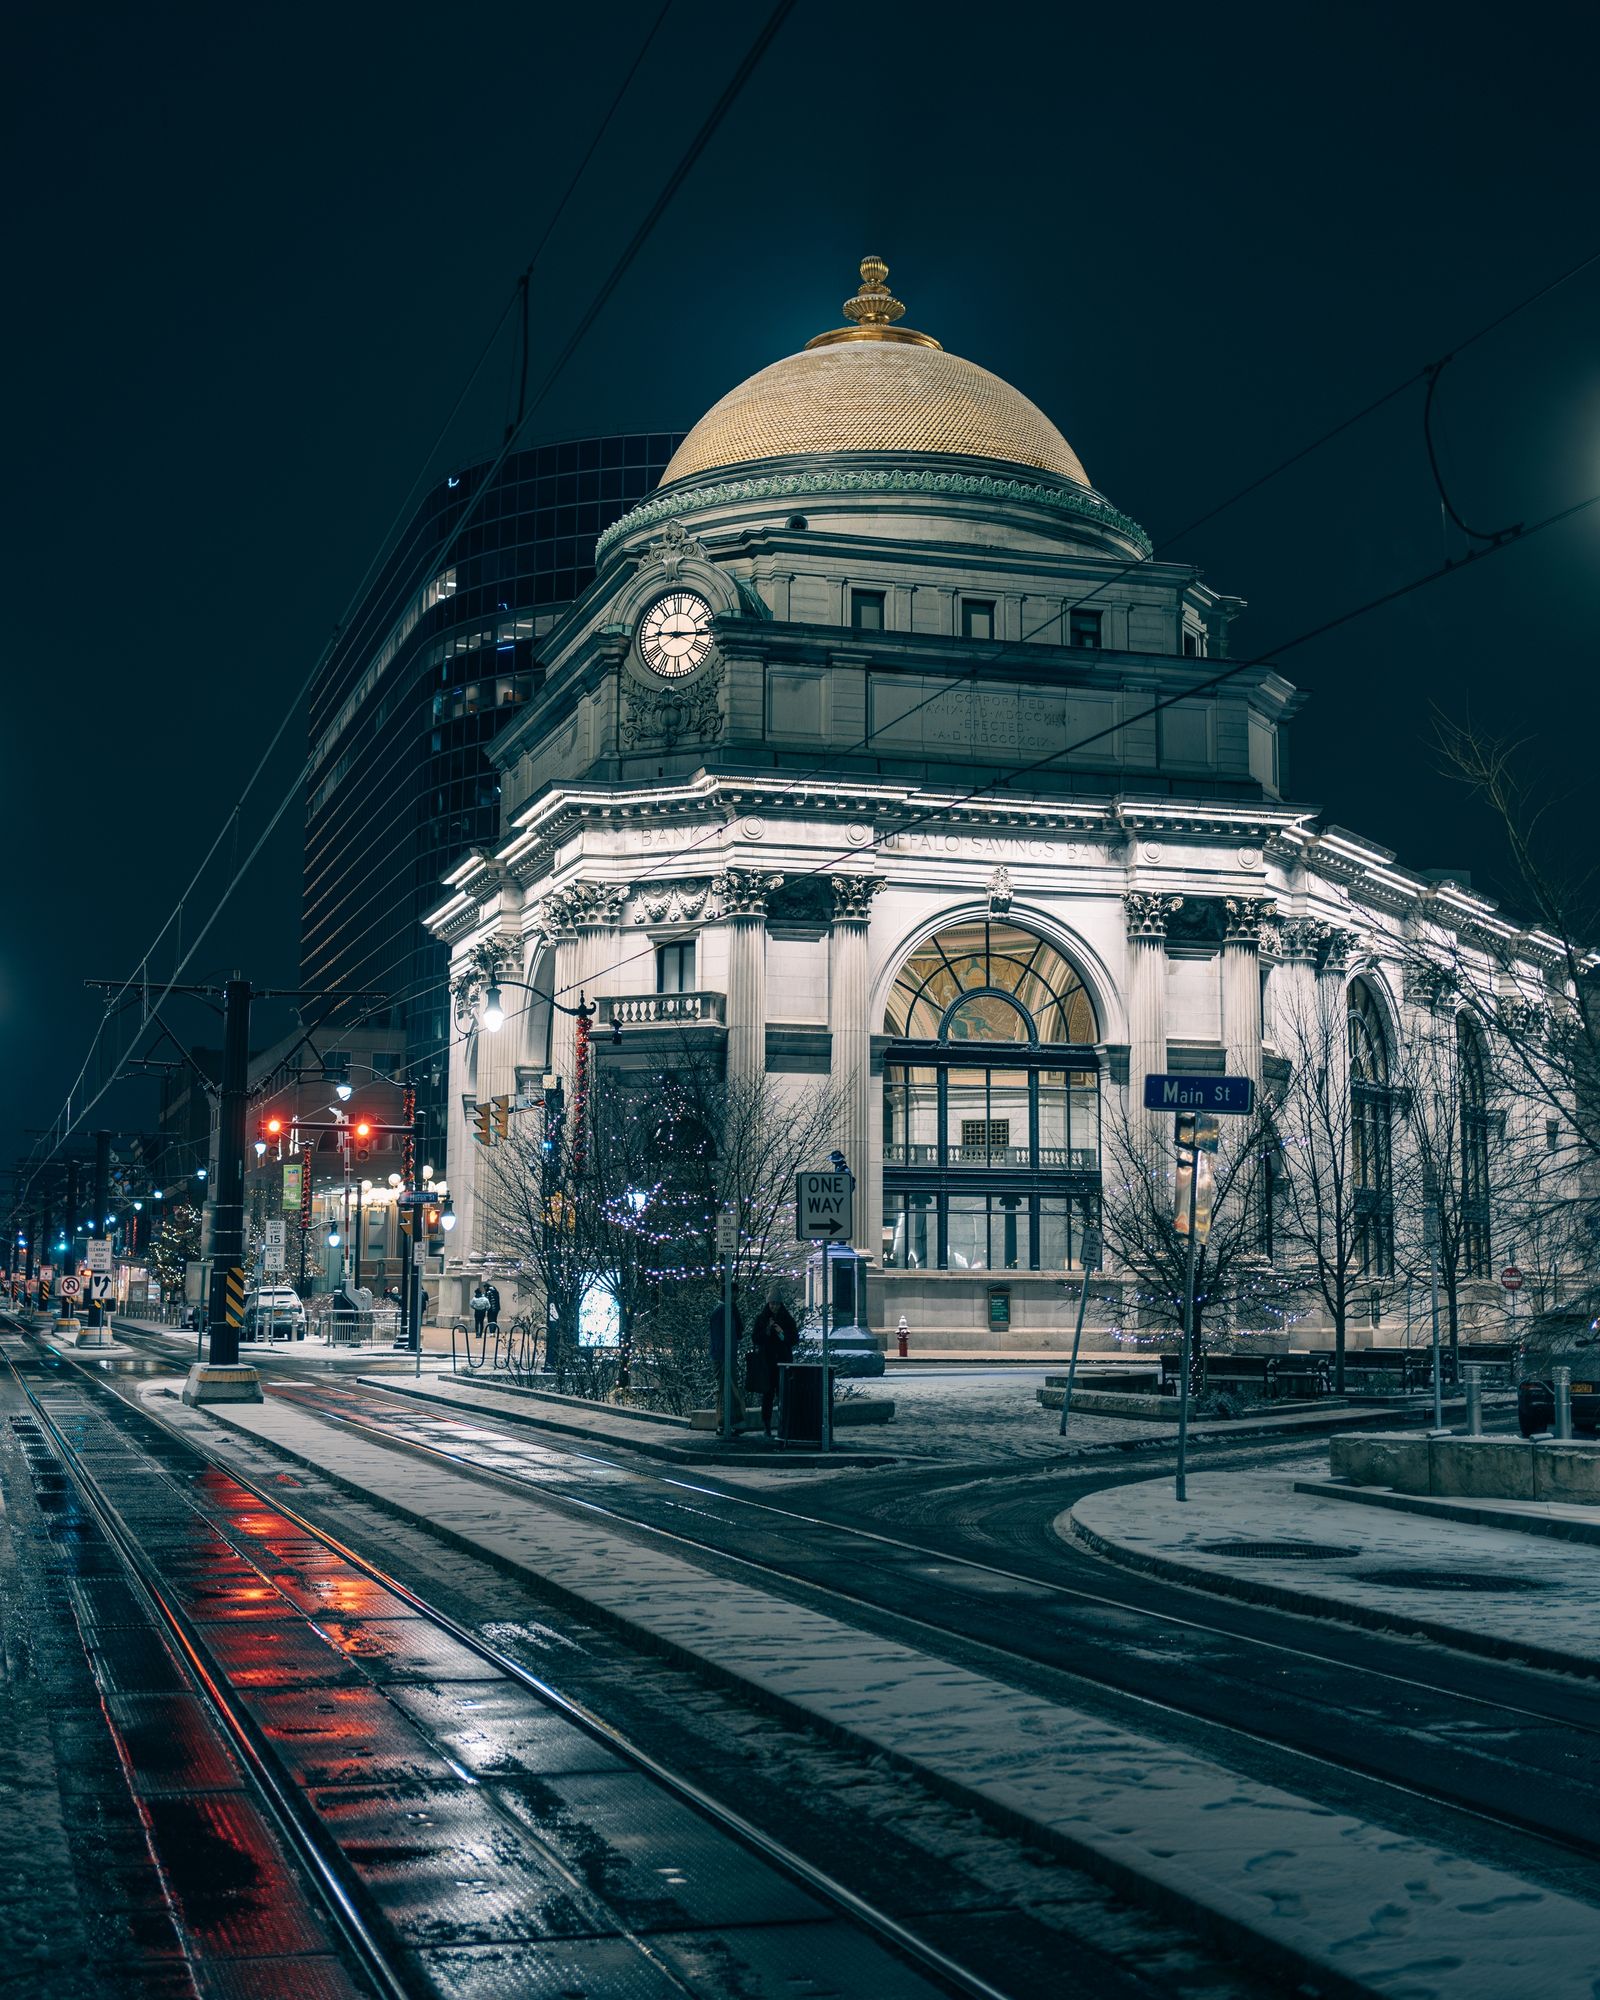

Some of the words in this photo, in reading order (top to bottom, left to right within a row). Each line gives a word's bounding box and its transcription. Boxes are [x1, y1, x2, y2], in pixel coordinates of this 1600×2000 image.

[641, 824, 702, 847] BANK
[873, 829, 960, 852] BUFFALO
[971, 836, 1055, 858] SAVINGS
[1067, 841, 1118, 861] BANK
[1163, 1081, 1204, 1104] Main
[1214, 1086, 1230, 1101] St
[808, 1176, 844, 1193] ONE
[807, 1197, 844, 1213] WAY
[722, 1217, 732, 1225] NO
[270, 1235, 281, 1244] 15
